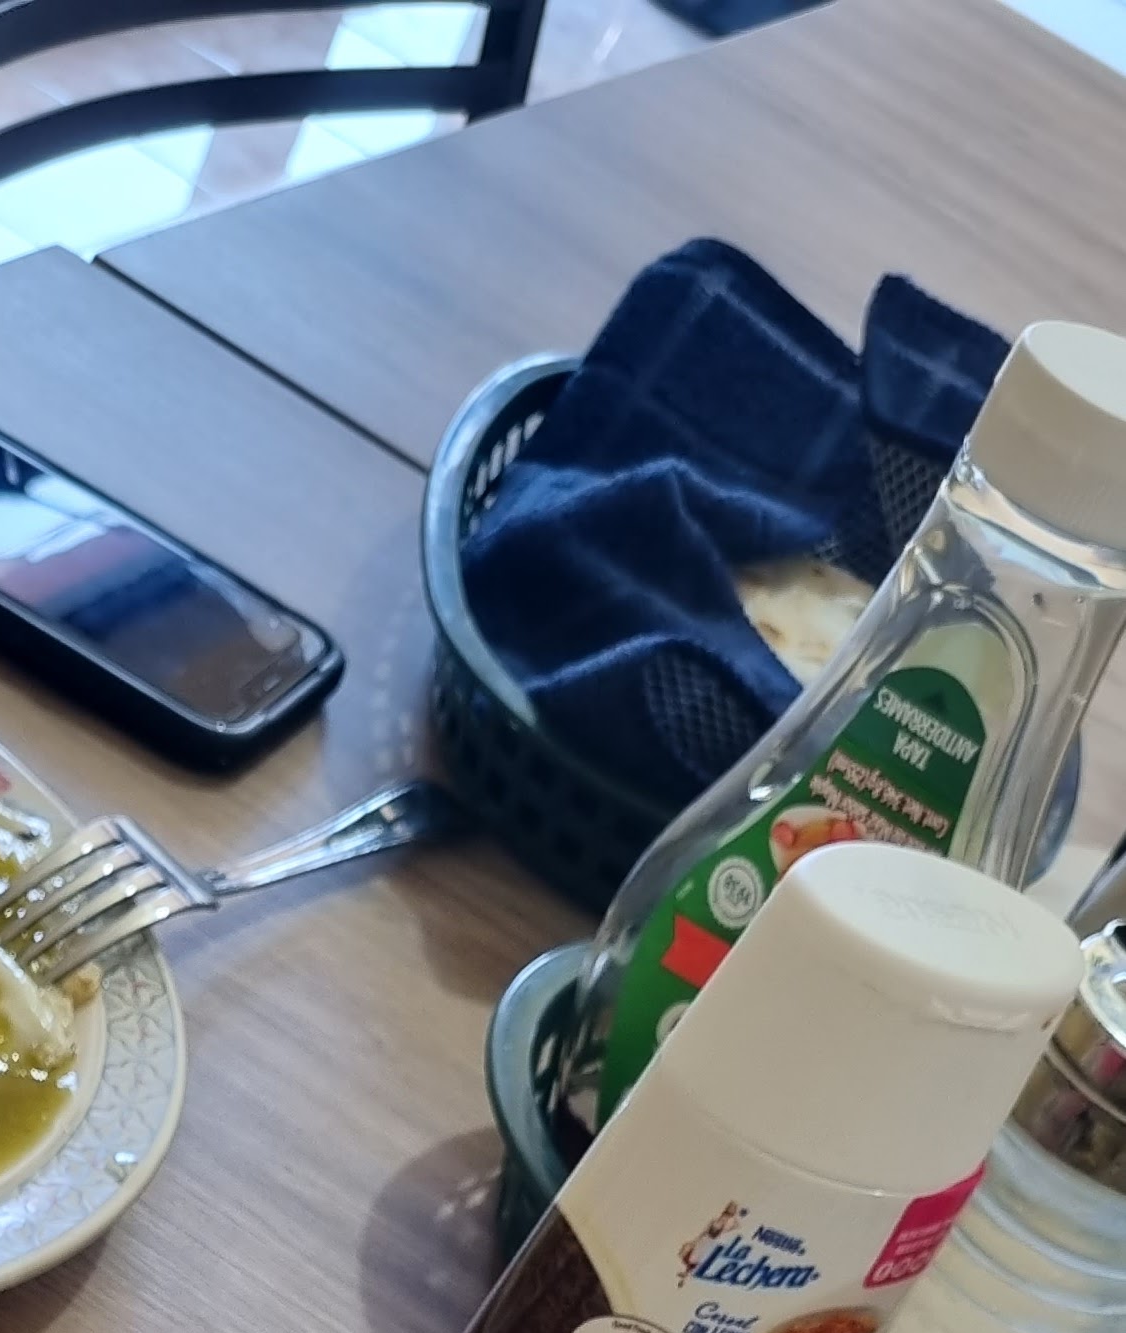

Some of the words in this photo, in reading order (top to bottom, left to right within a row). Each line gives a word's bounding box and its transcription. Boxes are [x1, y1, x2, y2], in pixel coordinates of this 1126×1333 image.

[874, 686, 981, 765] ANTIDERRAMES
[892, 730, 932, 772] TAPA
[693, 1245, 815, 1291] Lechera
